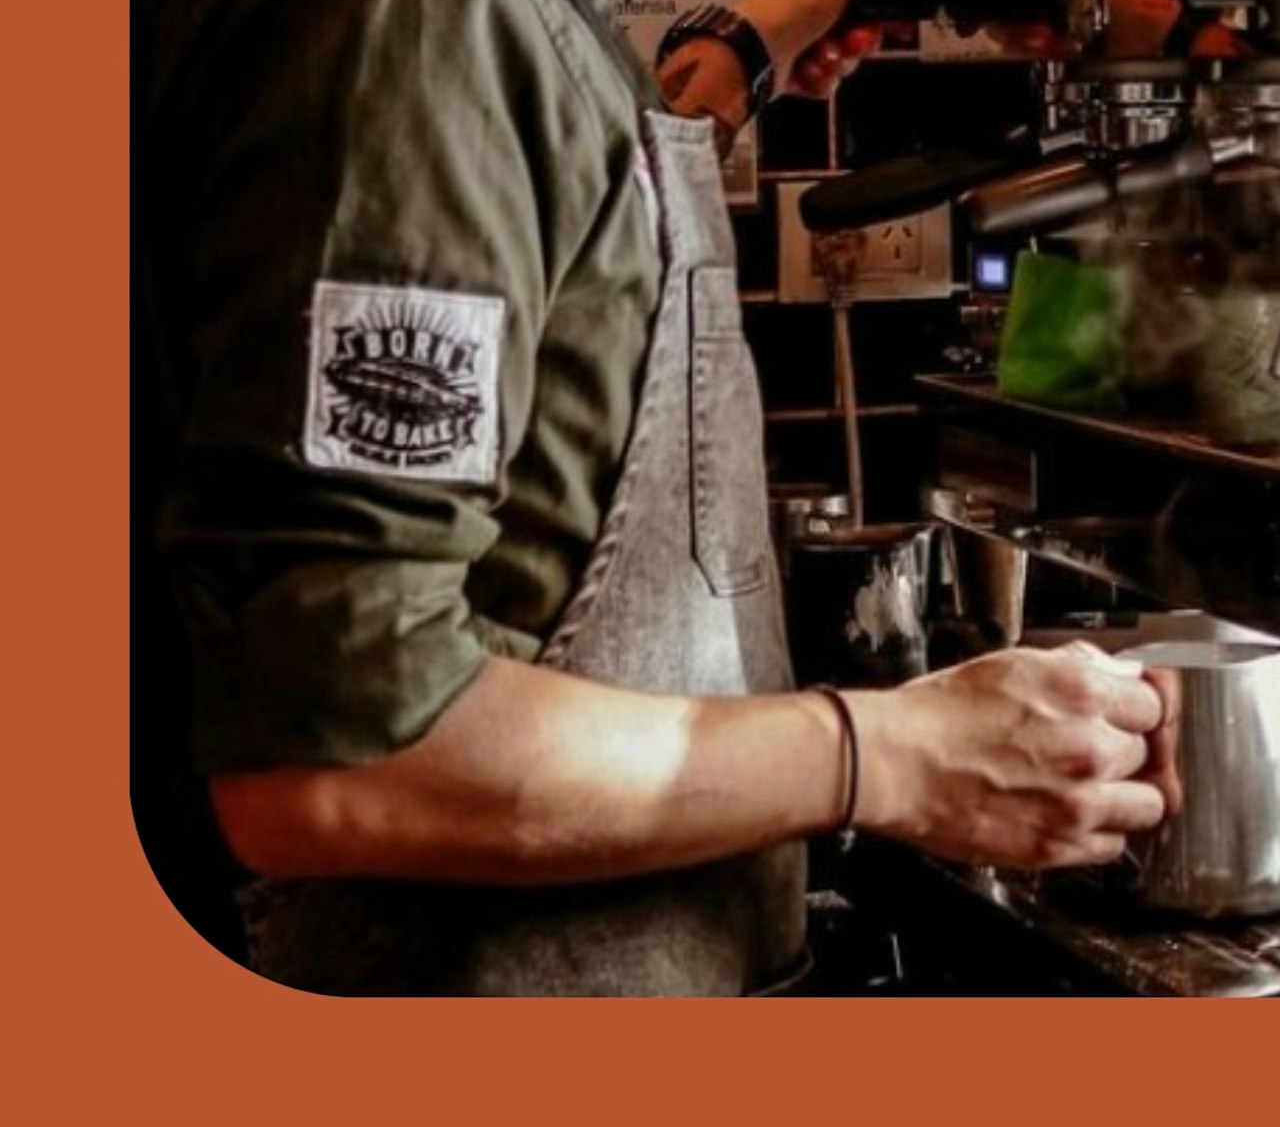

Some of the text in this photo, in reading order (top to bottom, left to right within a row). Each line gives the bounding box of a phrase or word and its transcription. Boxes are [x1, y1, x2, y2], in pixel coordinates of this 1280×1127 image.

[365, 327, 451, 370] BORN
[360, 410, 454, 448] TO BAKE
